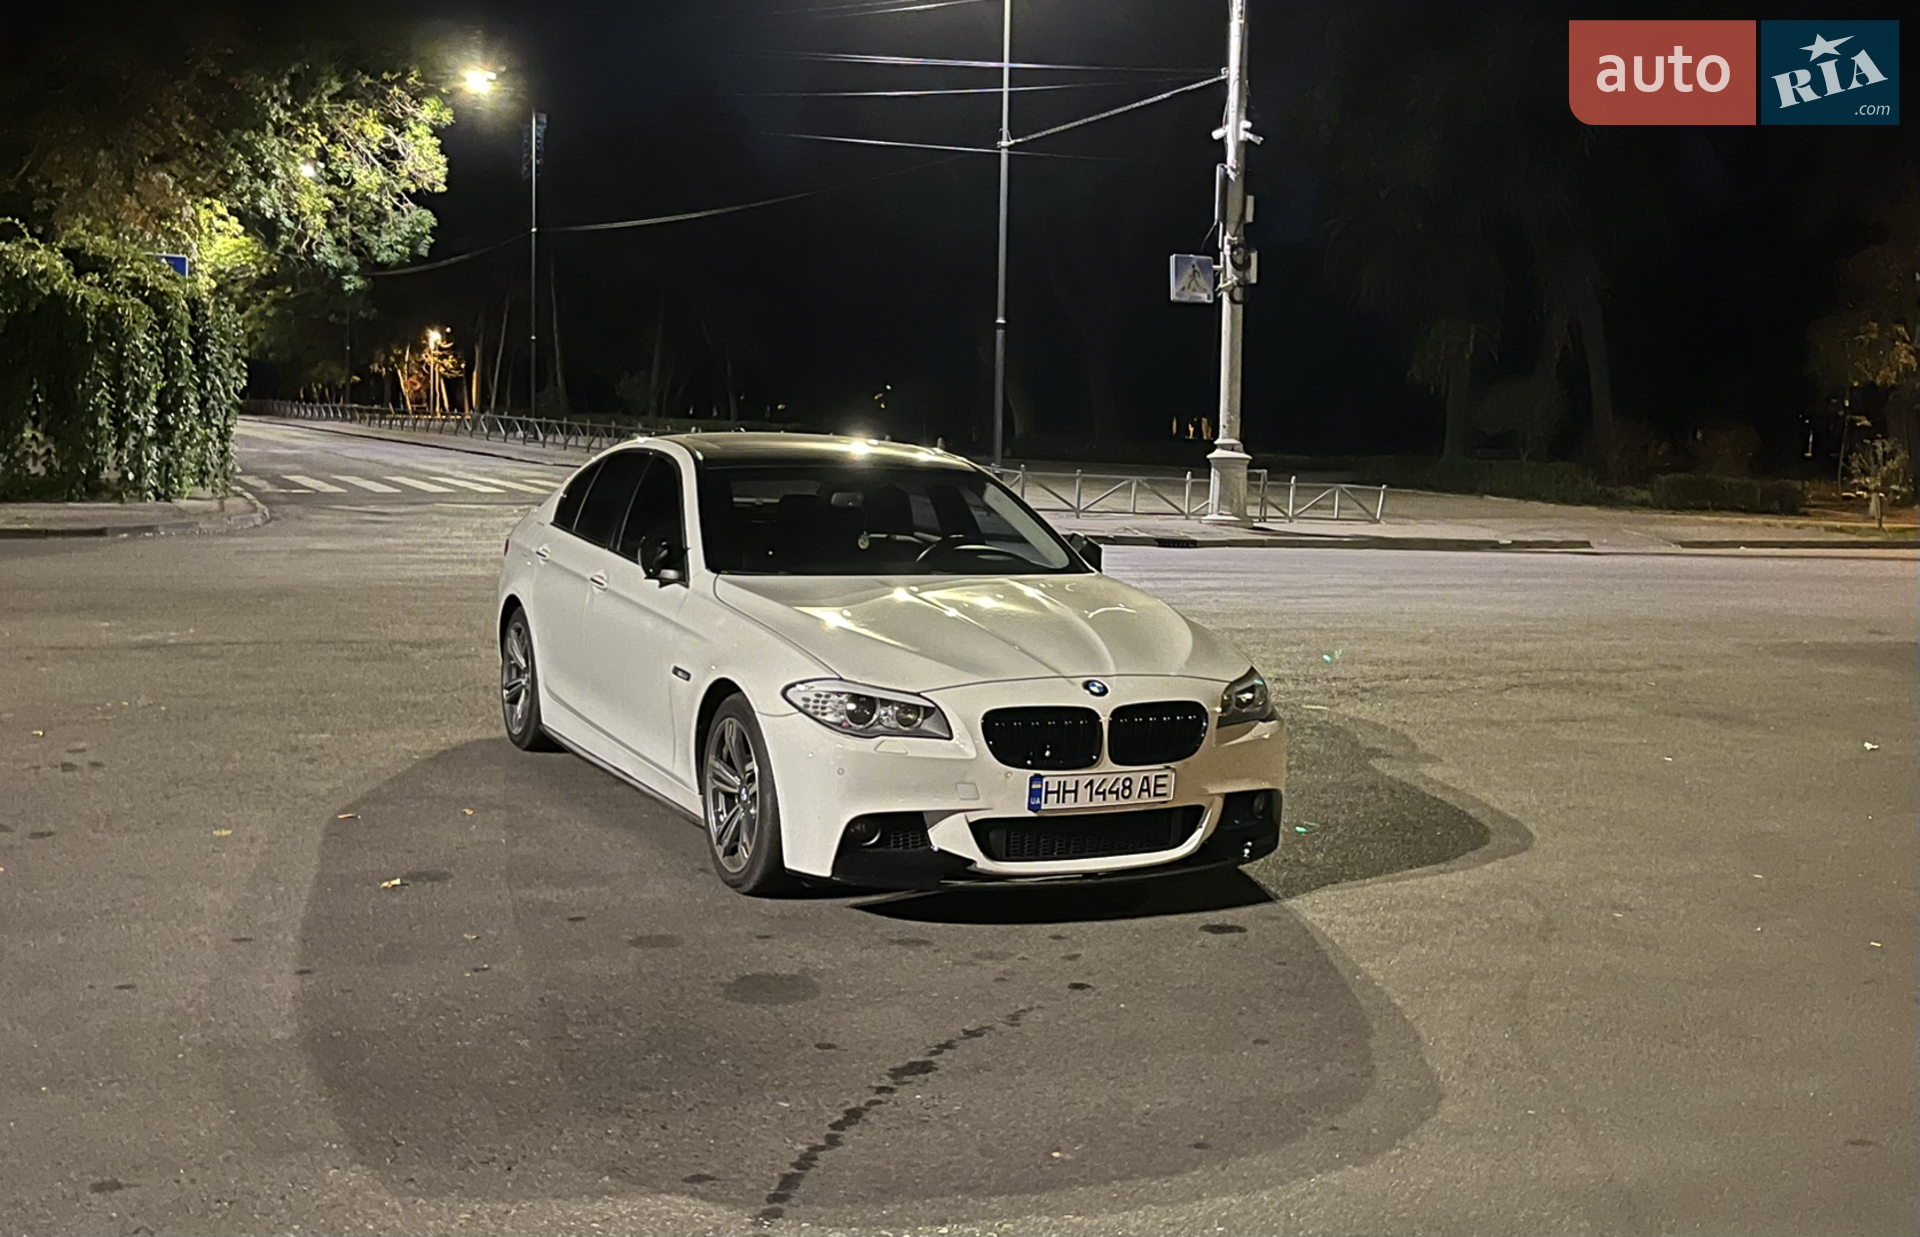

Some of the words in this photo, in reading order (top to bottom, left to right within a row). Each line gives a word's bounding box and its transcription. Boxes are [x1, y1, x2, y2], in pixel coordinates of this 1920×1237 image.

[1044, 779, 1079, 804] HH
[1083, 777, 1133, 802] 1448
[1137, 774, 1168, 799] AE
[1030, 797, 1041, 805] UA
